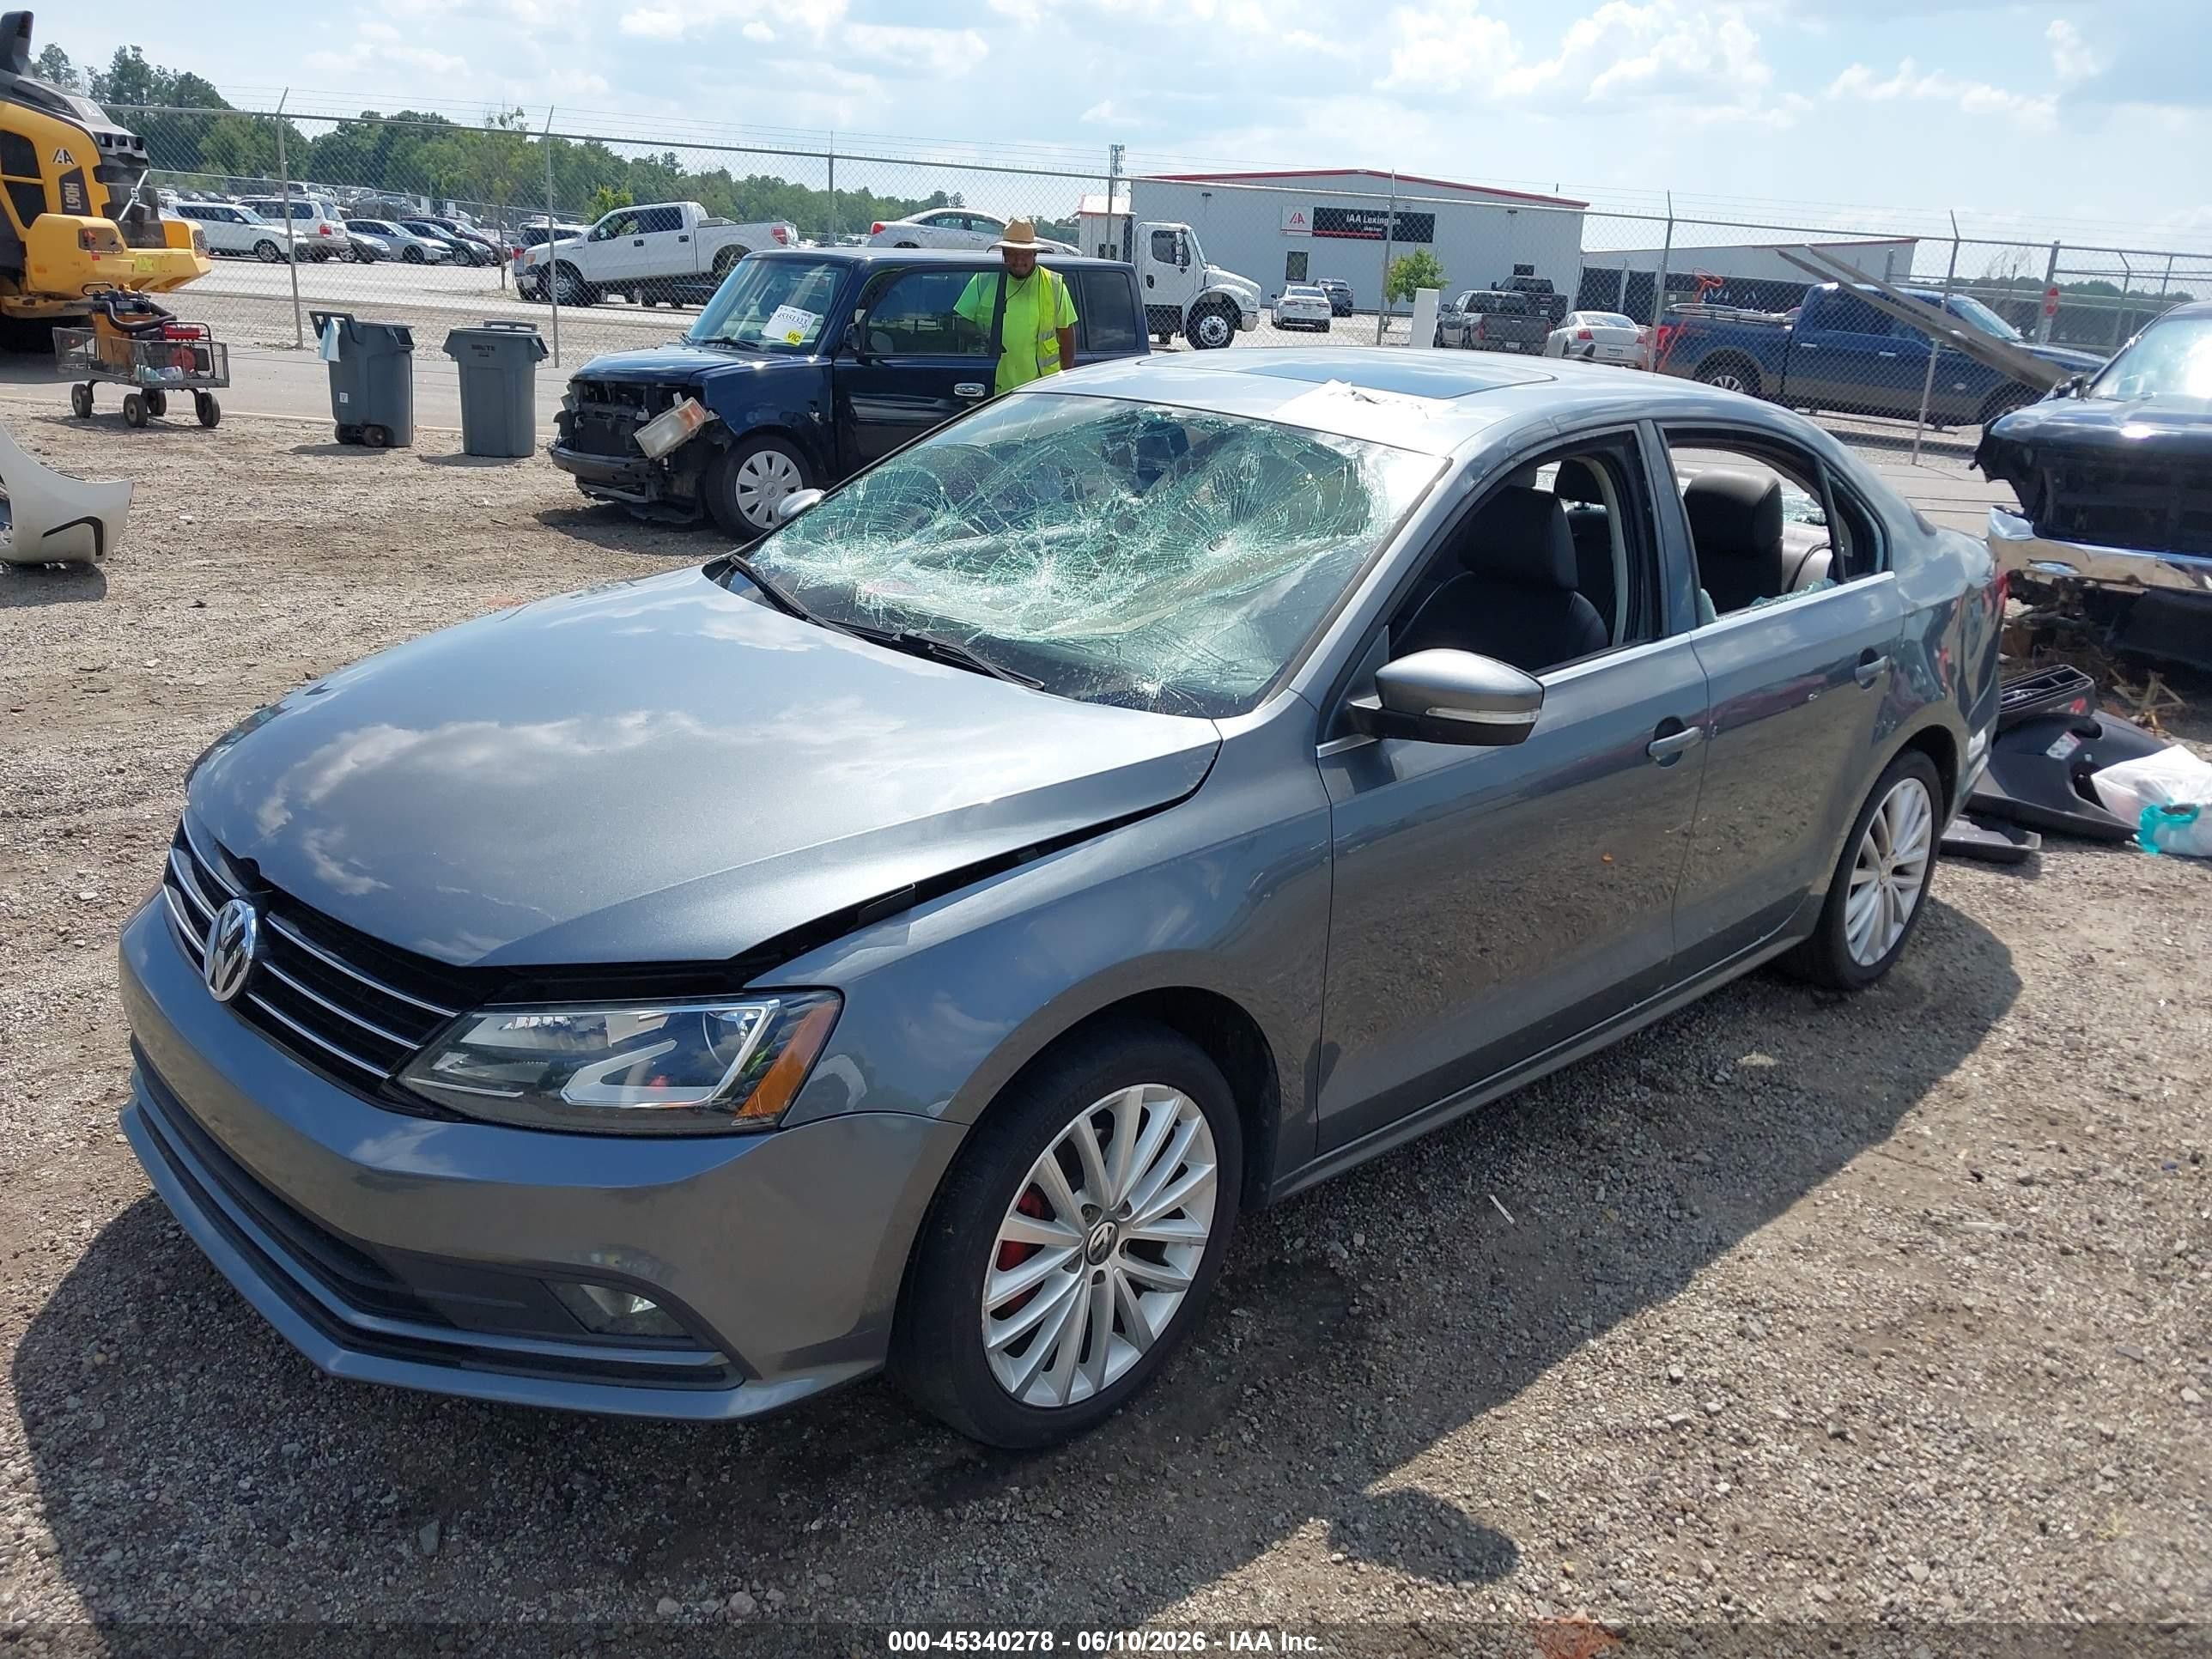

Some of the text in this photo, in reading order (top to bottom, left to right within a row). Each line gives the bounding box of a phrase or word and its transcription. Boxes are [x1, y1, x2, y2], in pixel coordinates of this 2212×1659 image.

[64, 183, 81, 210] L90H
[1346, 214, 1401, 227] IAA Lexingon
[787, 331, 801, 343] VIC
